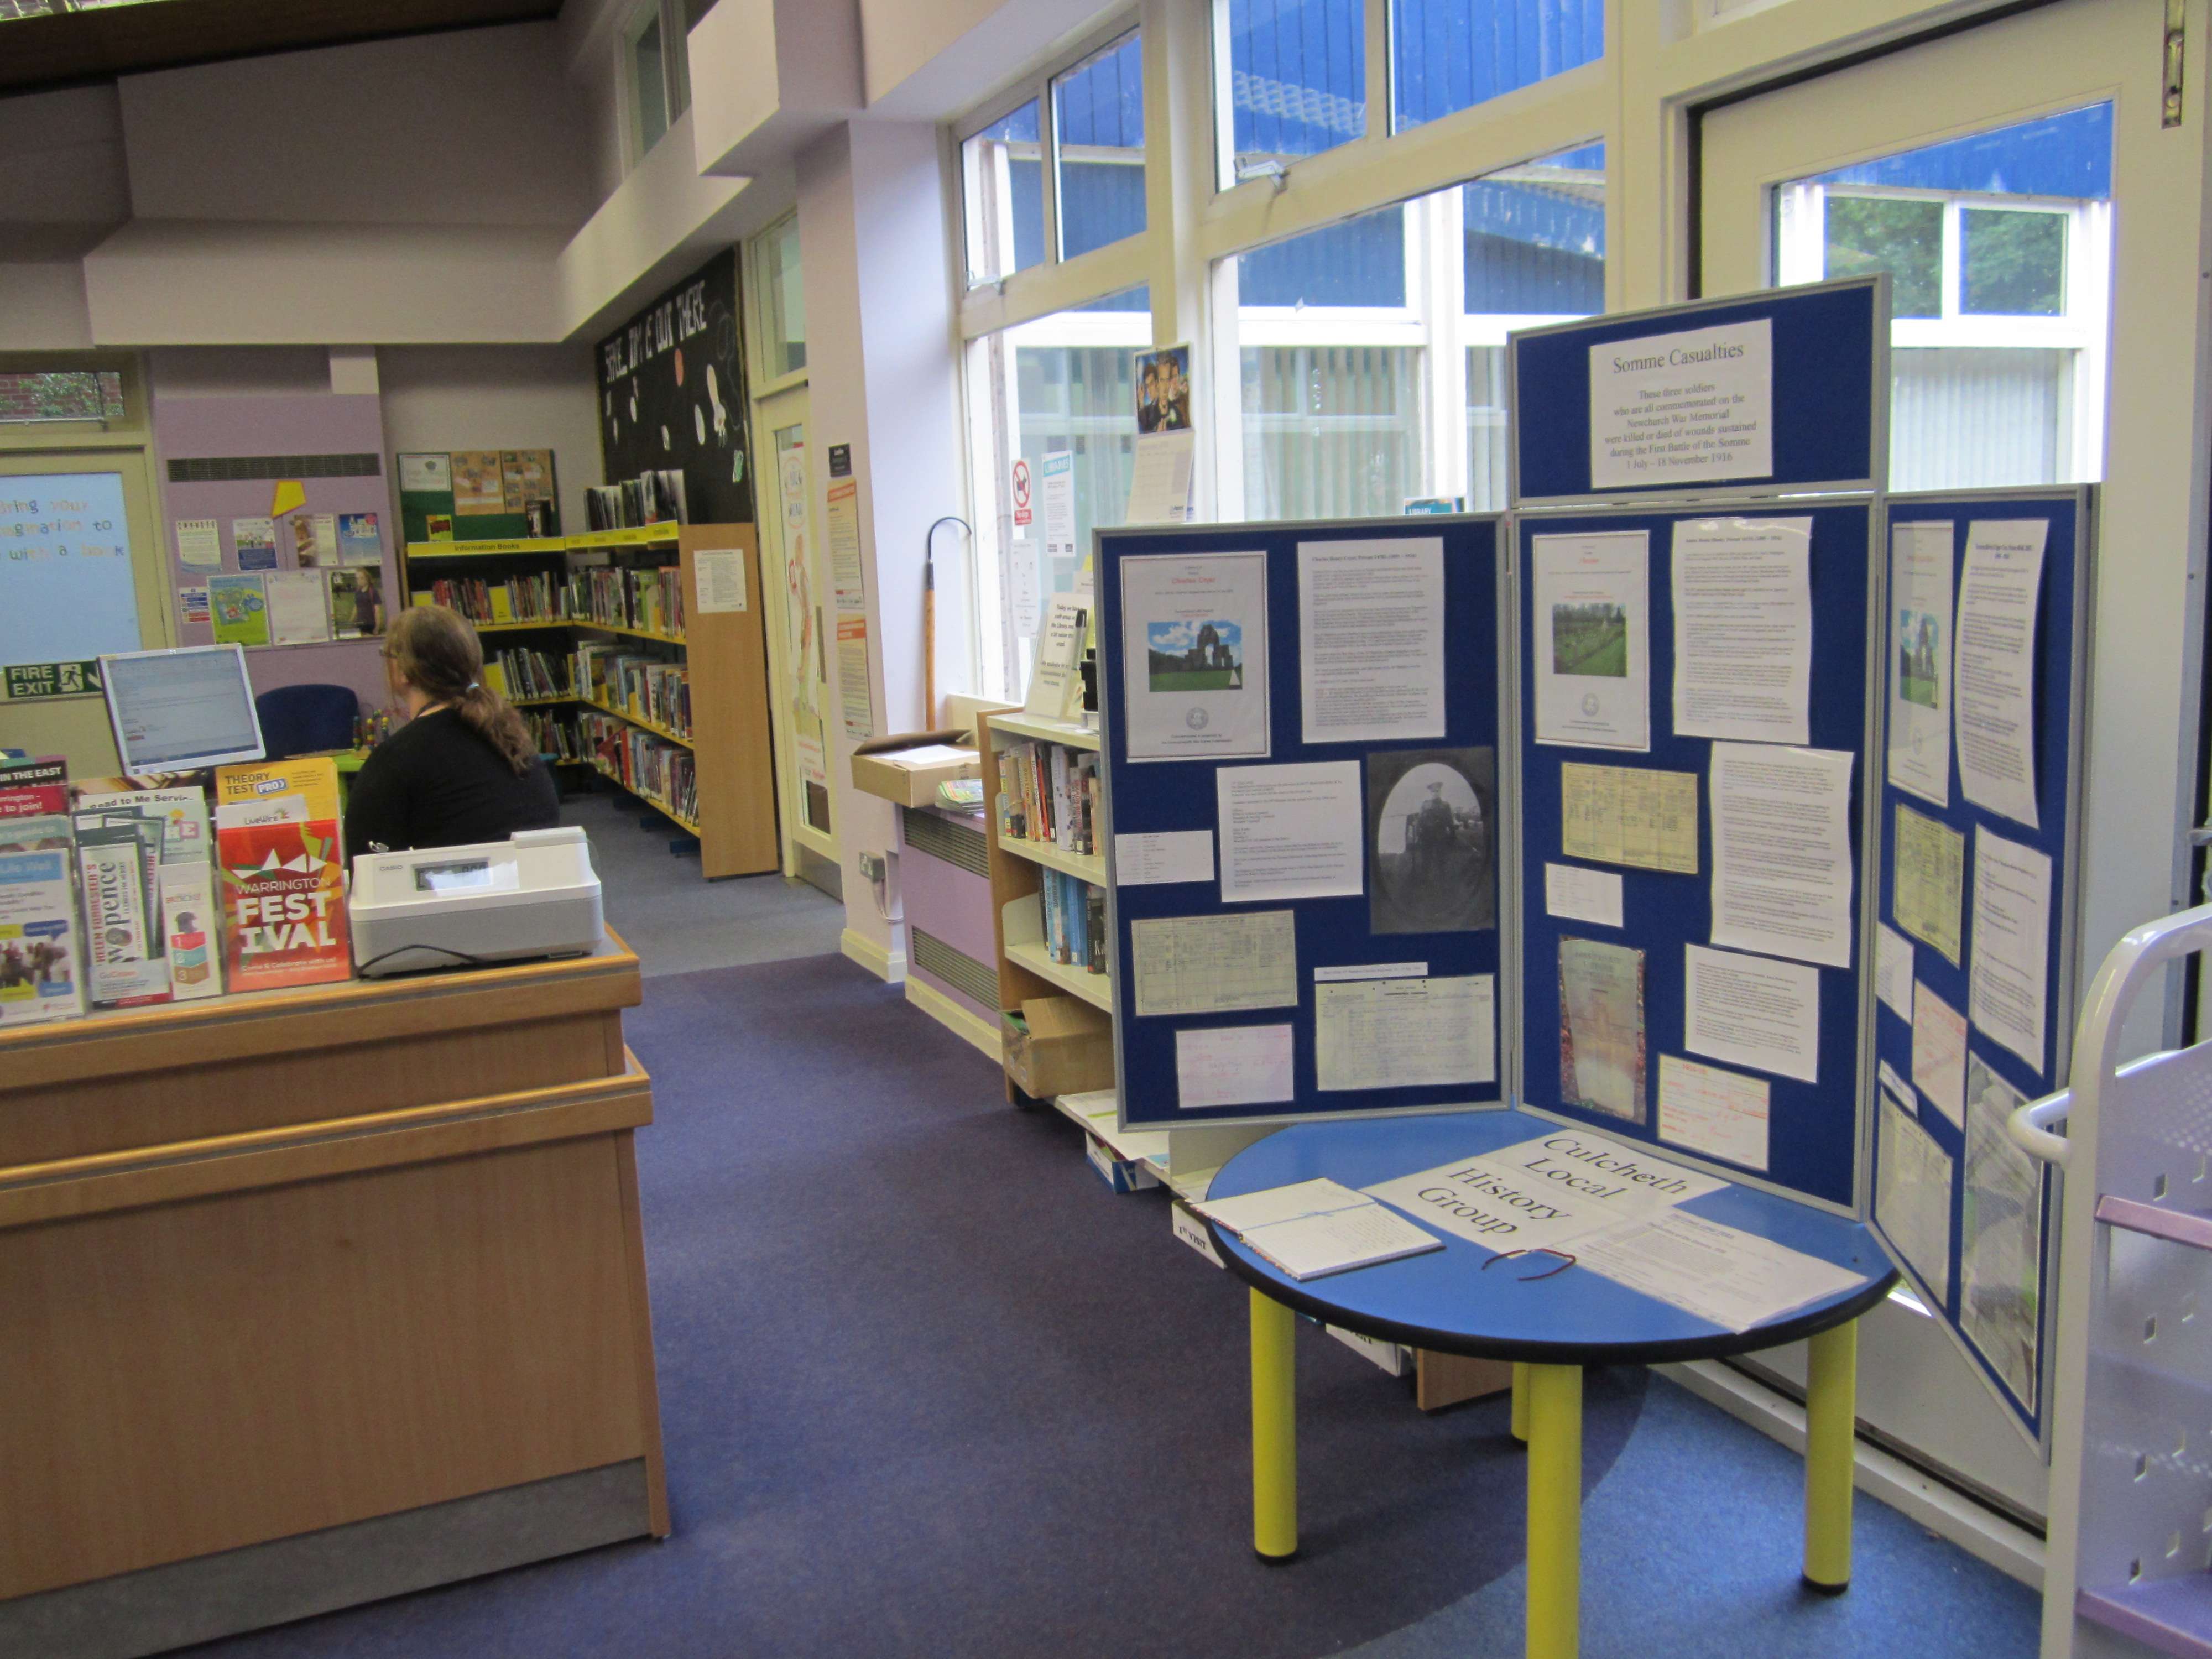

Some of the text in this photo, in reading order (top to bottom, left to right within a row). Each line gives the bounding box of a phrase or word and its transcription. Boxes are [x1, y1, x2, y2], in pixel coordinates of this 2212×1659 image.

[676, 280, 707, 342] THERE
[1613, 342, 1744, 373] Somme Casualties
[1639, 384, 1715, 400] These three soldiers
[1613, 394, 1745, 416] who are all commemorated on the
[1627, 409, 1730, 428] Newchurch War Memorial
[1604, 436, 1621, 444] were
[1624, 431, 1645, 442] killed
[1656, 430, 1672, 439] died
[1674, 428, 1684, 437] of
[1685, 425, 1715, 436] wounds
[1717, 420, 1757, 434] sustained
[1610, 437, 1751, 458] during the First Battle of the Somme
[1633, 458, 1648, 471] July
[1658, 457, 1667, 467] 18
[1669, 454, 1708, 466] November
[1711, 451, 1733, 462] 1916
[93, 520, 112, 531] to
[58, 545, 67, 556] a
[454, 544, 496, 552] Information
[11, 666, 53, 680] FIRE
[13, 681, 54, 696] EXIT
[12, 770, 34, 780] THE
[35, 766, 61, 778] EAST
[225, 772, 270, 785] THEORY
[226, 783, 255, 795] TEST
[19, 801, 43, 813] join!
[244, 815, 279, 825] LiveWire
[236, 876, 331, 894] WARRINGTON
[86, 864, 106, 963] HELEN FORRESTER'S
[237, 891, 331, 925] FEST
[176, 937, 182, 947] 1
[239, 921, 337, 954] IVAL
[176, 952, 185, 963] 2
[272, 960, 307, 968] Celebrate
[177, 969, 187, 980] 3
[1543, 1138, 1688, 1195] Culcheth
[1523, 1158, 1629, 1199] Local
[1446, 1167, 1573, 1220] History
[1417, 1187, 1518, 1235] Group
[1188, 1231, 1206, 1250] VISIT
